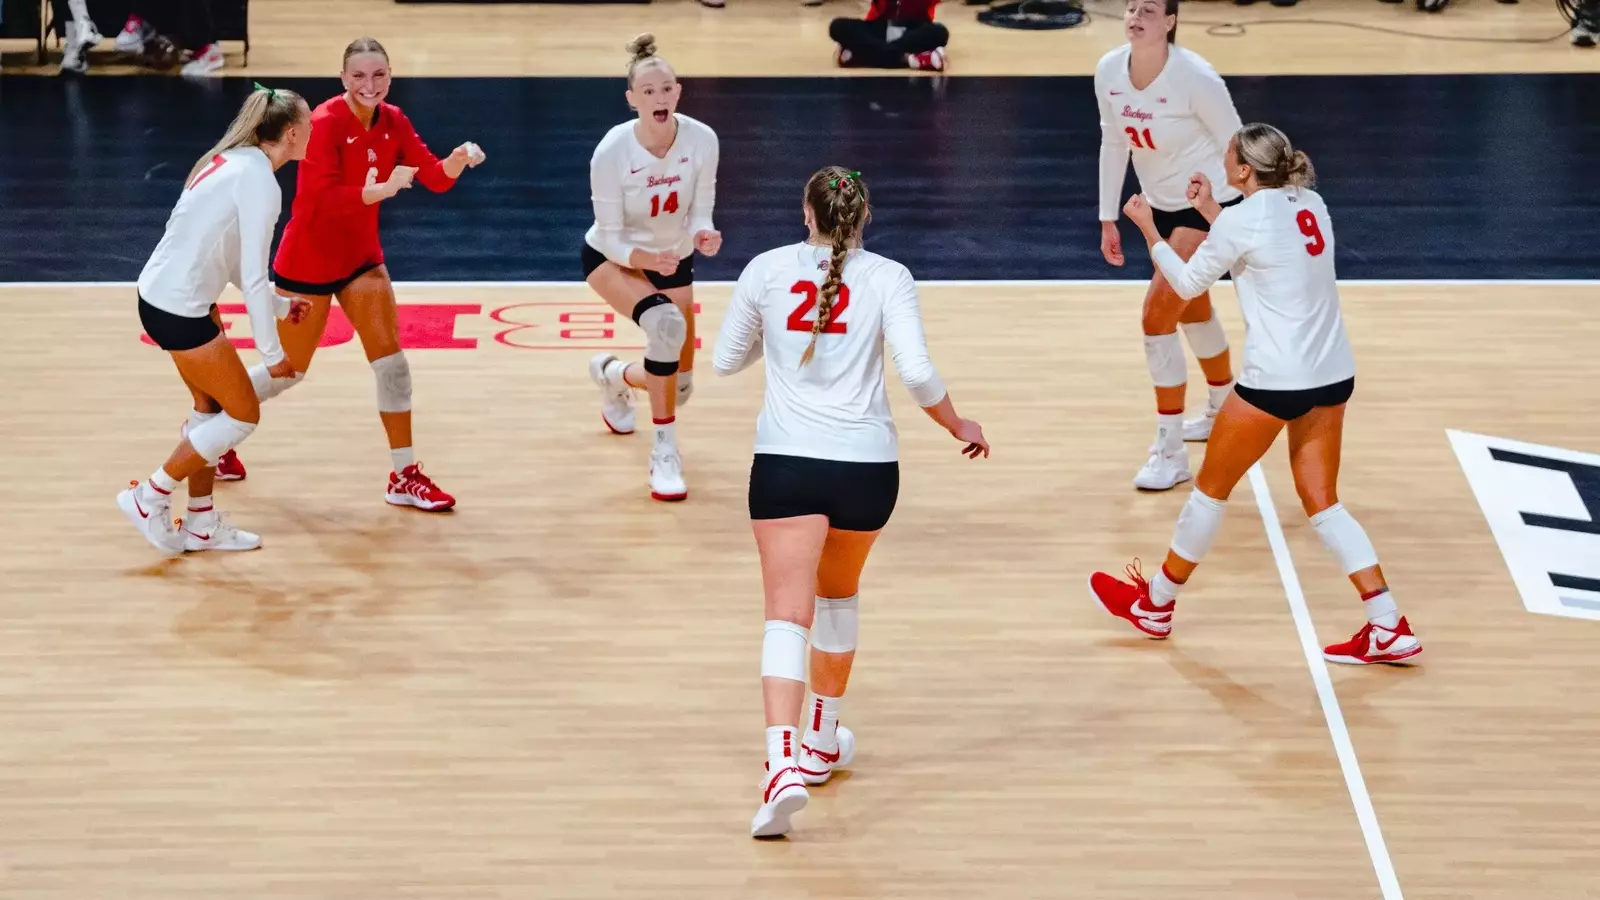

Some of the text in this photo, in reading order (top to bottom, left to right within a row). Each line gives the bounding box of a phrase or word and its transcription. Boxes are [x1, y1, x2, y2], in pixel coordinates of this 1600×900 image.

[1121, 104, 1153, 122] Buckeyes
[1124, 126, 1157, 150] 31
[647, 174, 682, 188] Buckeyes
[650, 191, 679, 217] 14
[1296, 209, 1325, 257] 9
[786, 280, 850, 334] 22
